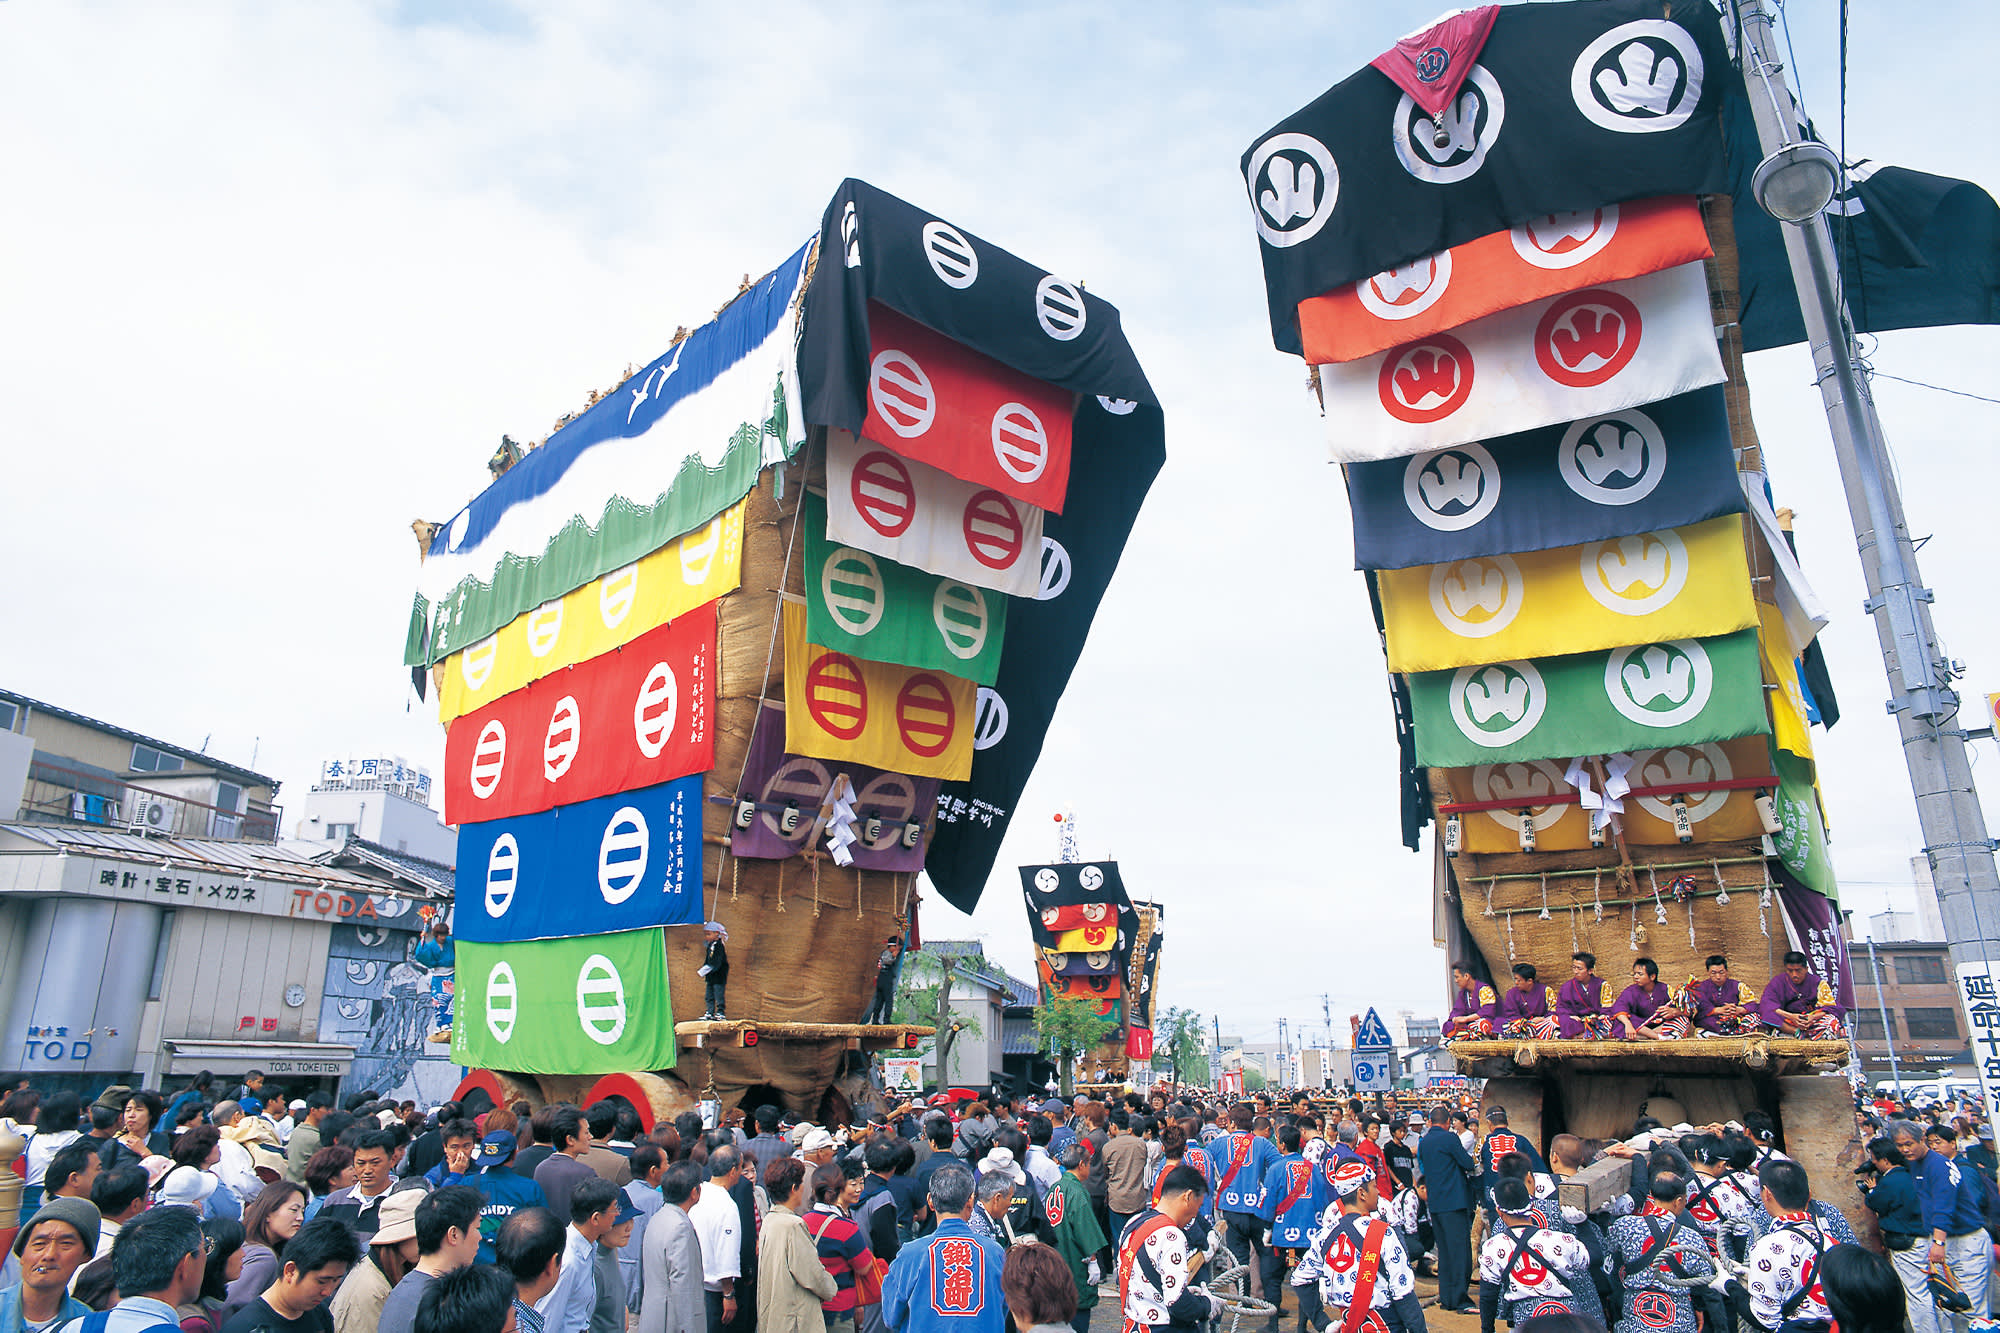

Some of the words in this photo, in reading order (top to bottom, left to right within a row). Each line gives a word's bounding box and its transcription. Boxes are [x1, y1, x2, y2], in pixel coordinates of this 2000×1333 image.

[293, 888, 378, 921] TODA
[237, 1015, 278, 1032] 戸田
[25, 1040, 92, 1060] TOD
[269, 1062, 293, 1073] TODA
[297, 1063, 340, 1073] TOKEITEN
